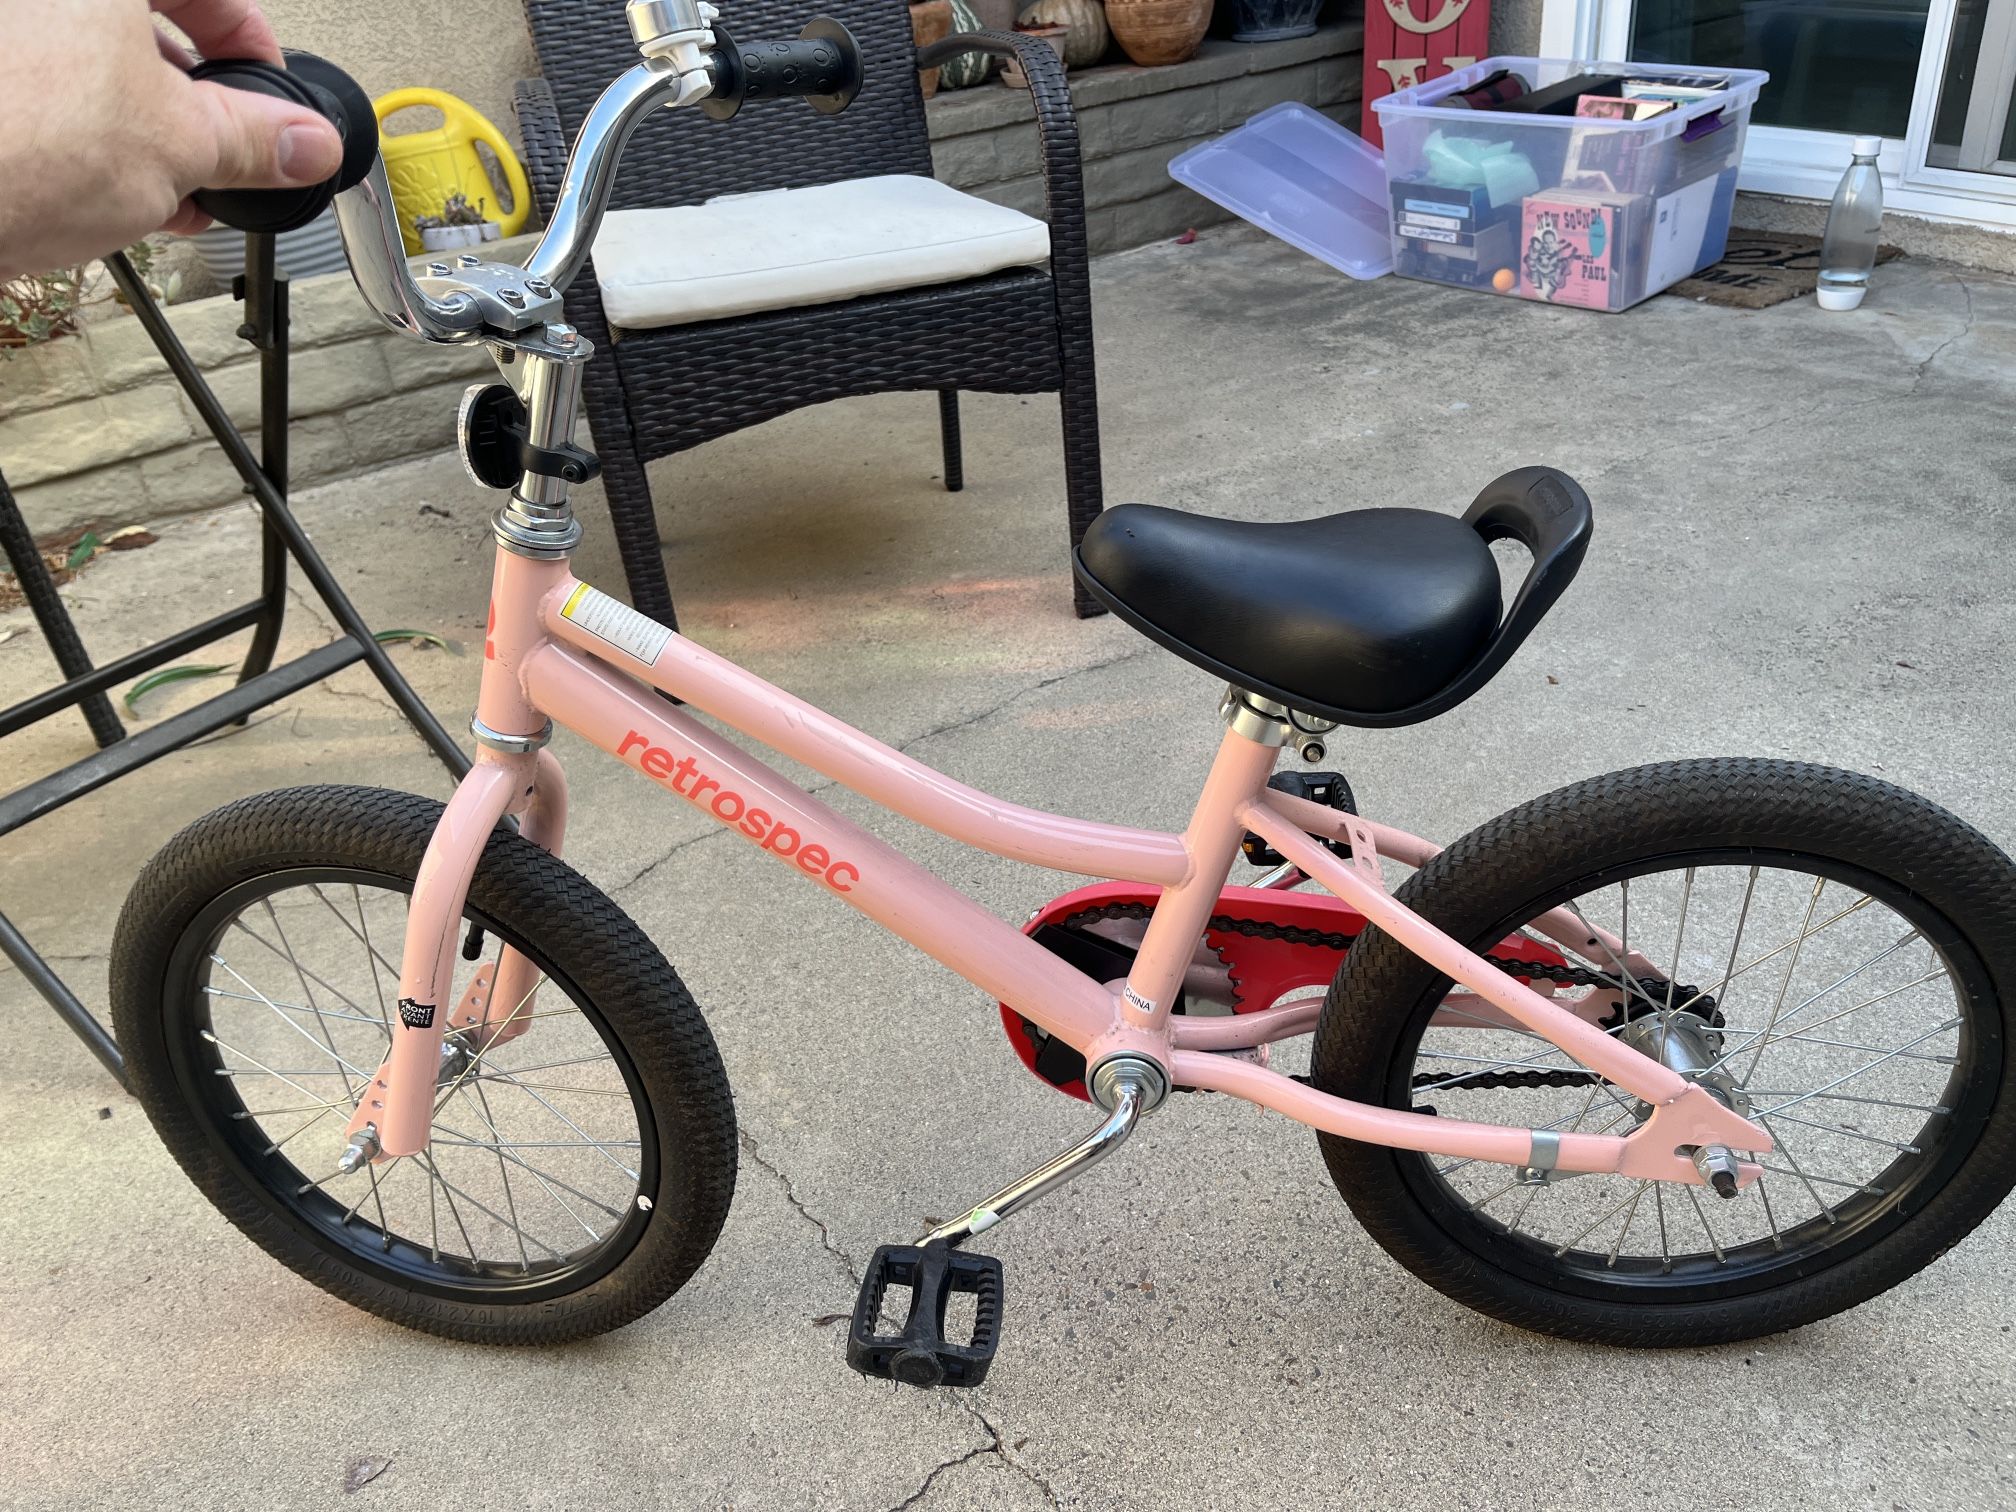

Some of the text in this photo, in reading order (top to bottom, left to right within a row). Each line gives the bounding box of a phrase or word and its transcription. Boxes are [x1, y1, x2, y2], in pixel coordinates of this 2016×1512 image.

[1536, 211, 1559, 230] NEW
[1582, 254, 1594, 264] LES
[1582, 265, 1606, 281] PAUL
[616, 729, 860, 892] retrospec
[1125, 987, 1150, 1011] CHINA
[401, 1007, 431, 1019] AVANT
[402, 1000, 432, 1014] FRONT
[477, 1310, 495, 1324] 16
